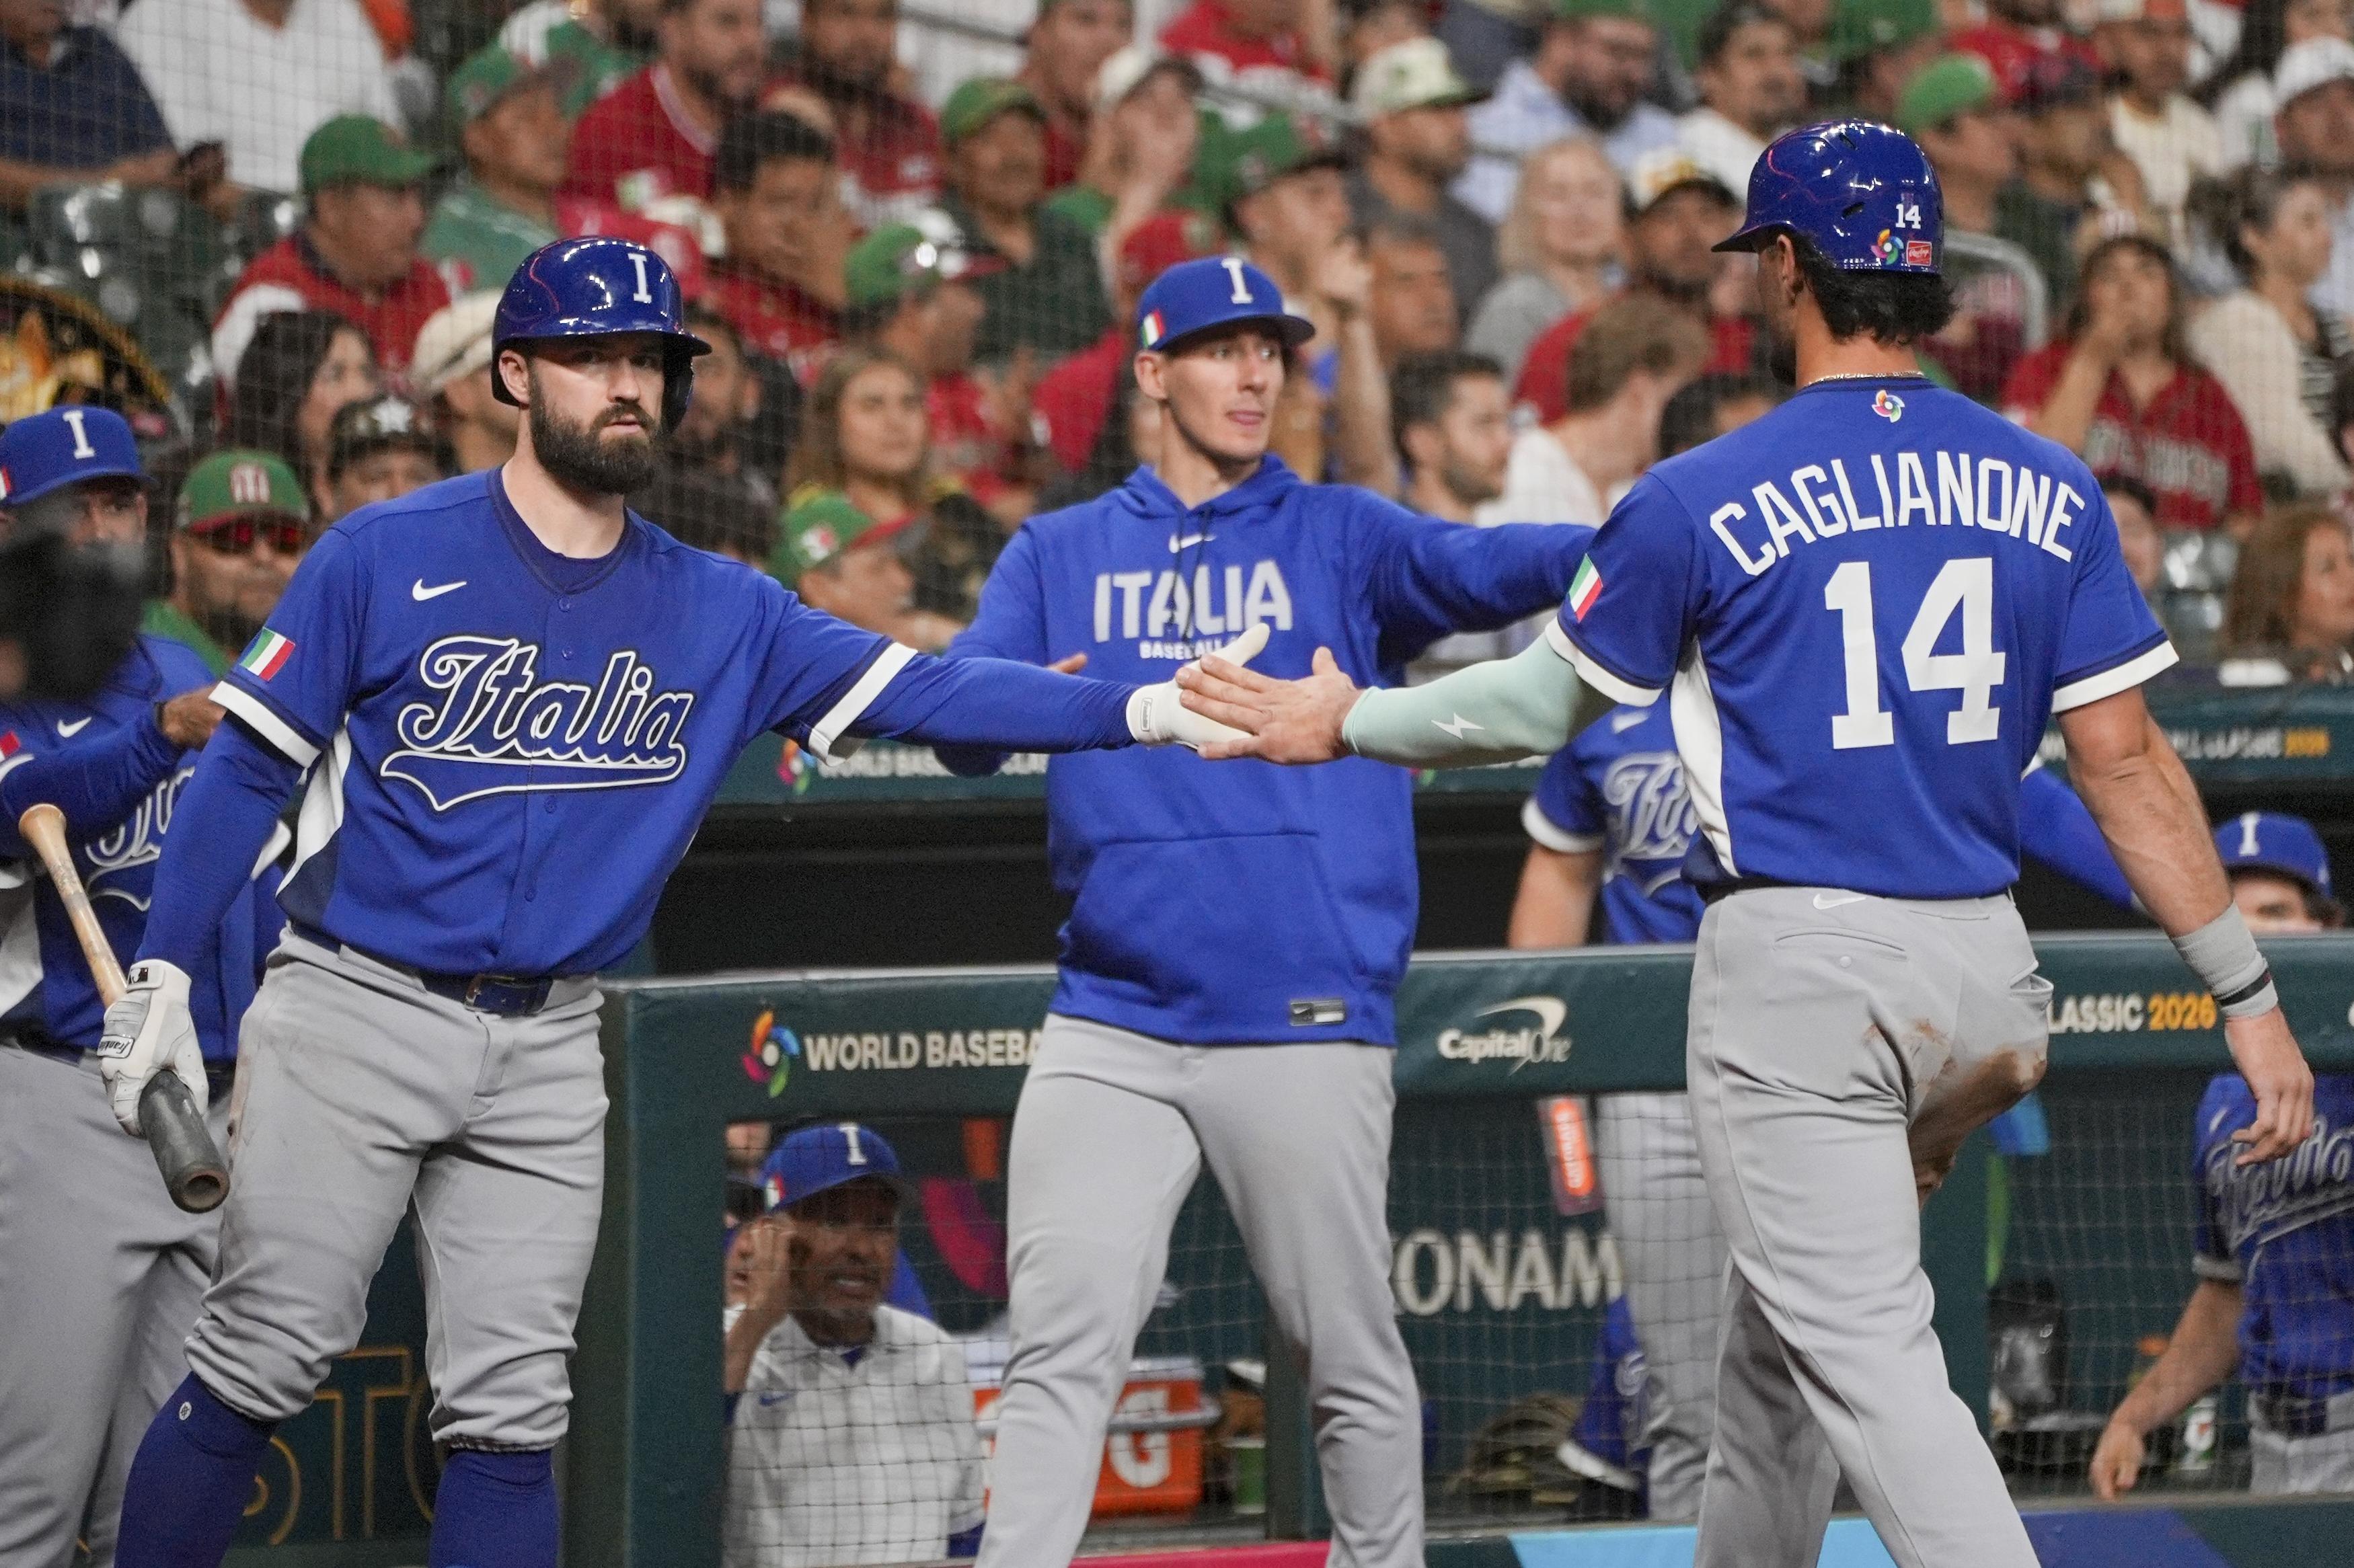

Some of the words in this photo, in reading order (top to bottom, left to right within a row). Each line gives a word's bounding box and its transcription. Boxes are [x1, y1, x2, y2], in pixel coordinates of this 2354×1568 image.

[1895, 204, 1922, 229] 14
[628, 253, 652, 304] I
[1221, 258, 1254, 304] I
[63, 409, 94, 459] I
[1710, 451, 2086, 576] CAGLIANONE
[1094, 559, 1293, 643] ITALIA
[1825, 557, 2006, 749] 14
[395, 635, 694, 768] Italia
[2238, 812, 2260, 857] I
[2047, 994, 2145, 1034] LASSIC
[2148, 991, 2217, 1031] 2026
[804, 1032, 921, 1071] WORLD
[925, 1029, 1044, 1067] BASEBA
[838, 1122, 867, 1165] I
[1392, 1229, 1624, 1316] ONAM
